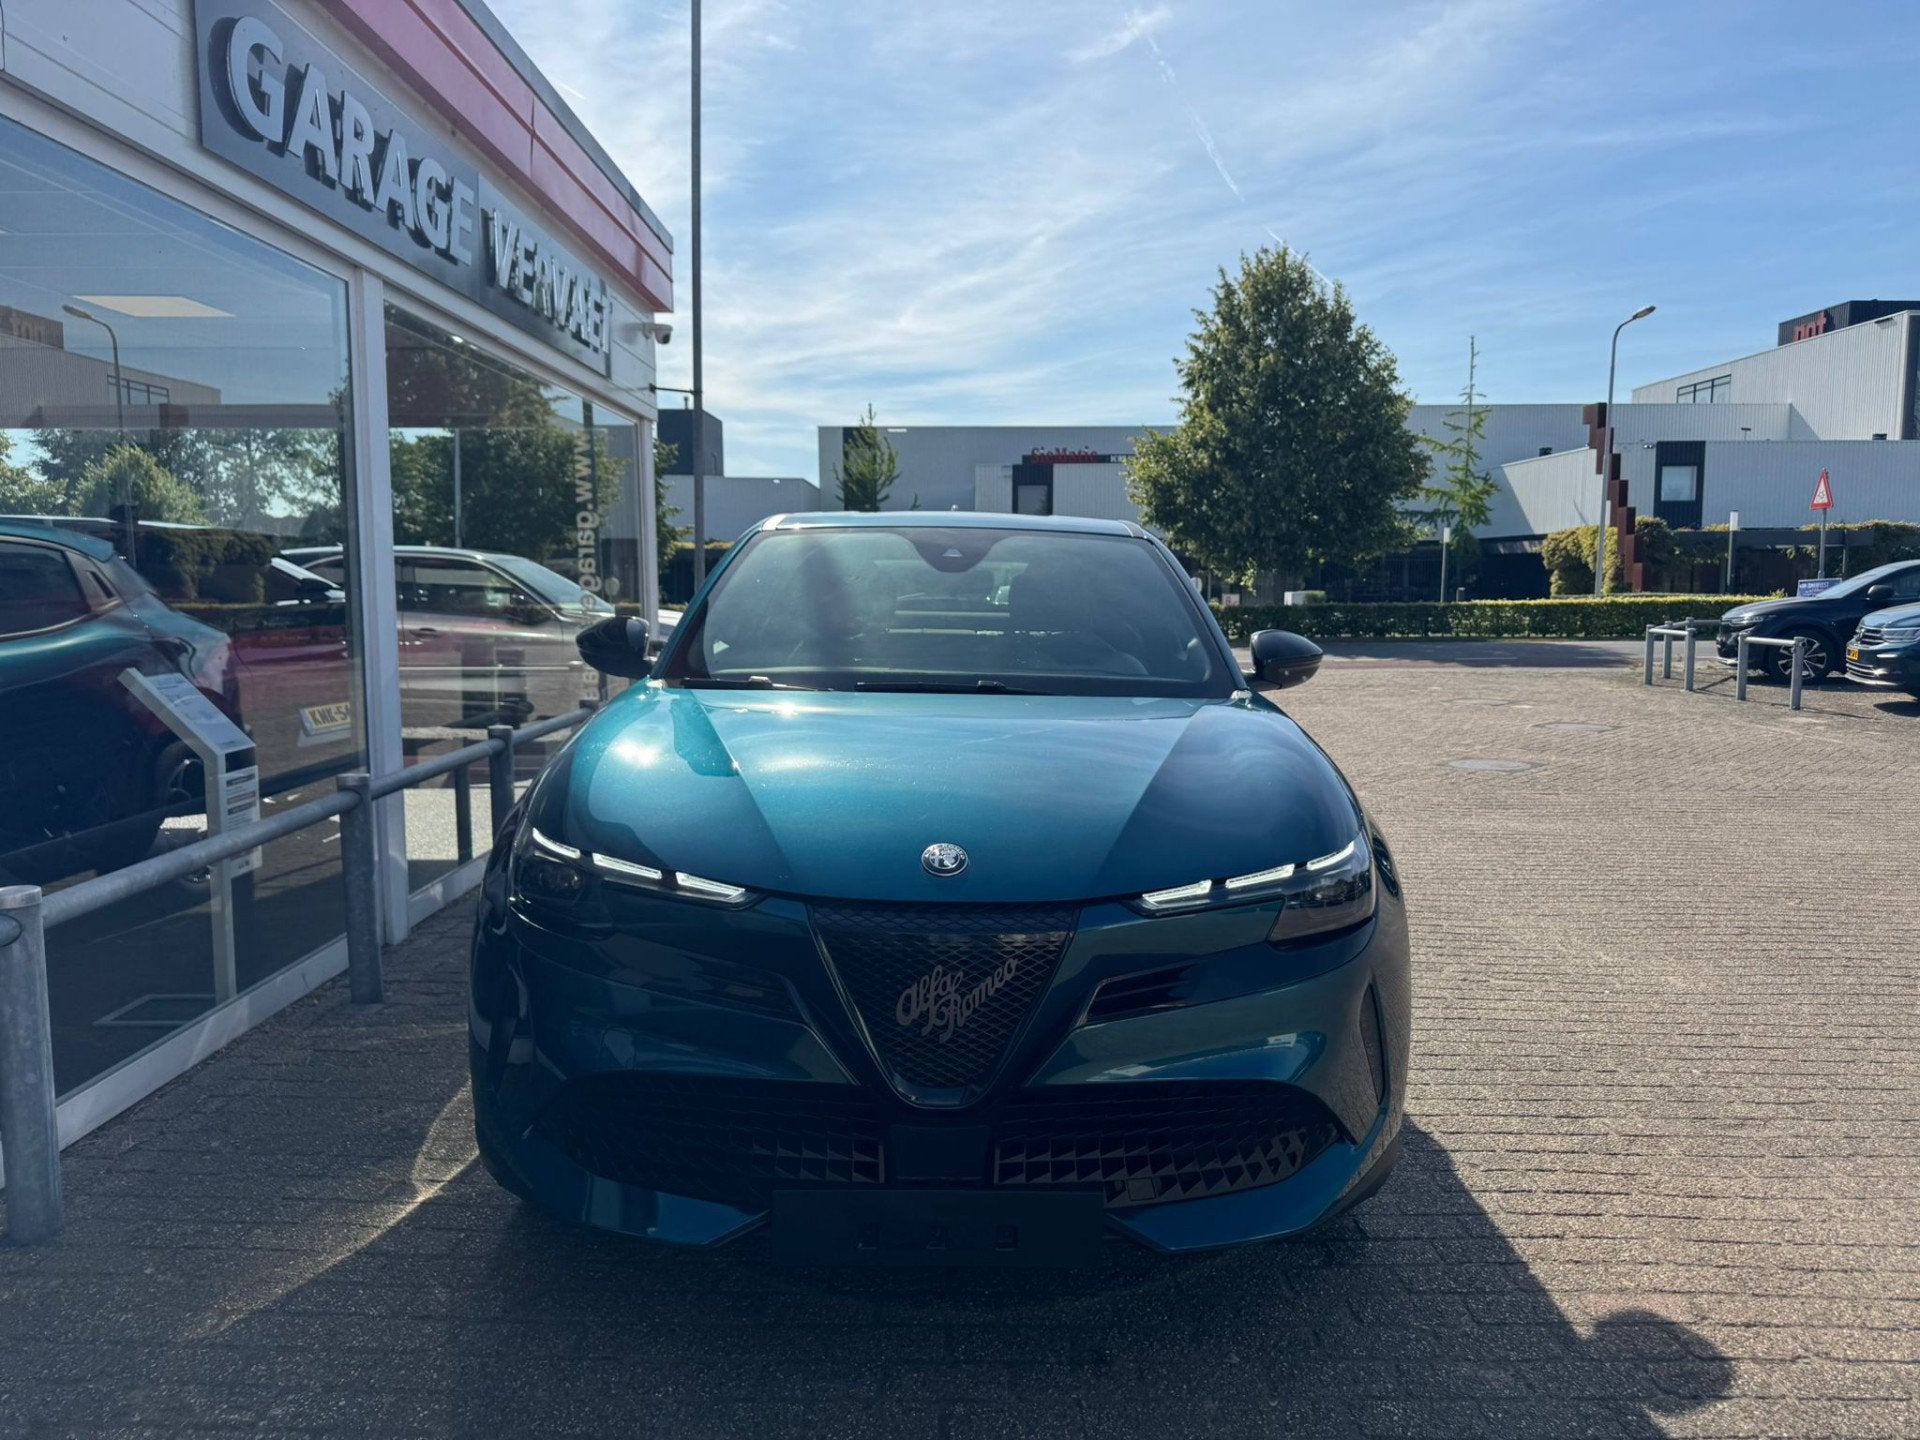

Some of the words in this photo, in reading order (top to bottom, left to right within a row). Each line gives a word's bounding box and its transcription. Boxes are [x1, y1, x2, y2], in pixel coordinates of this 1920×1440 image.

[226, 15, 475, 268] GARAGE
[491, 206, 613, 355] VERVAET
[896, 964, 963, 1037] Alfa
[933, 958, 1018, 1043] Romeo
